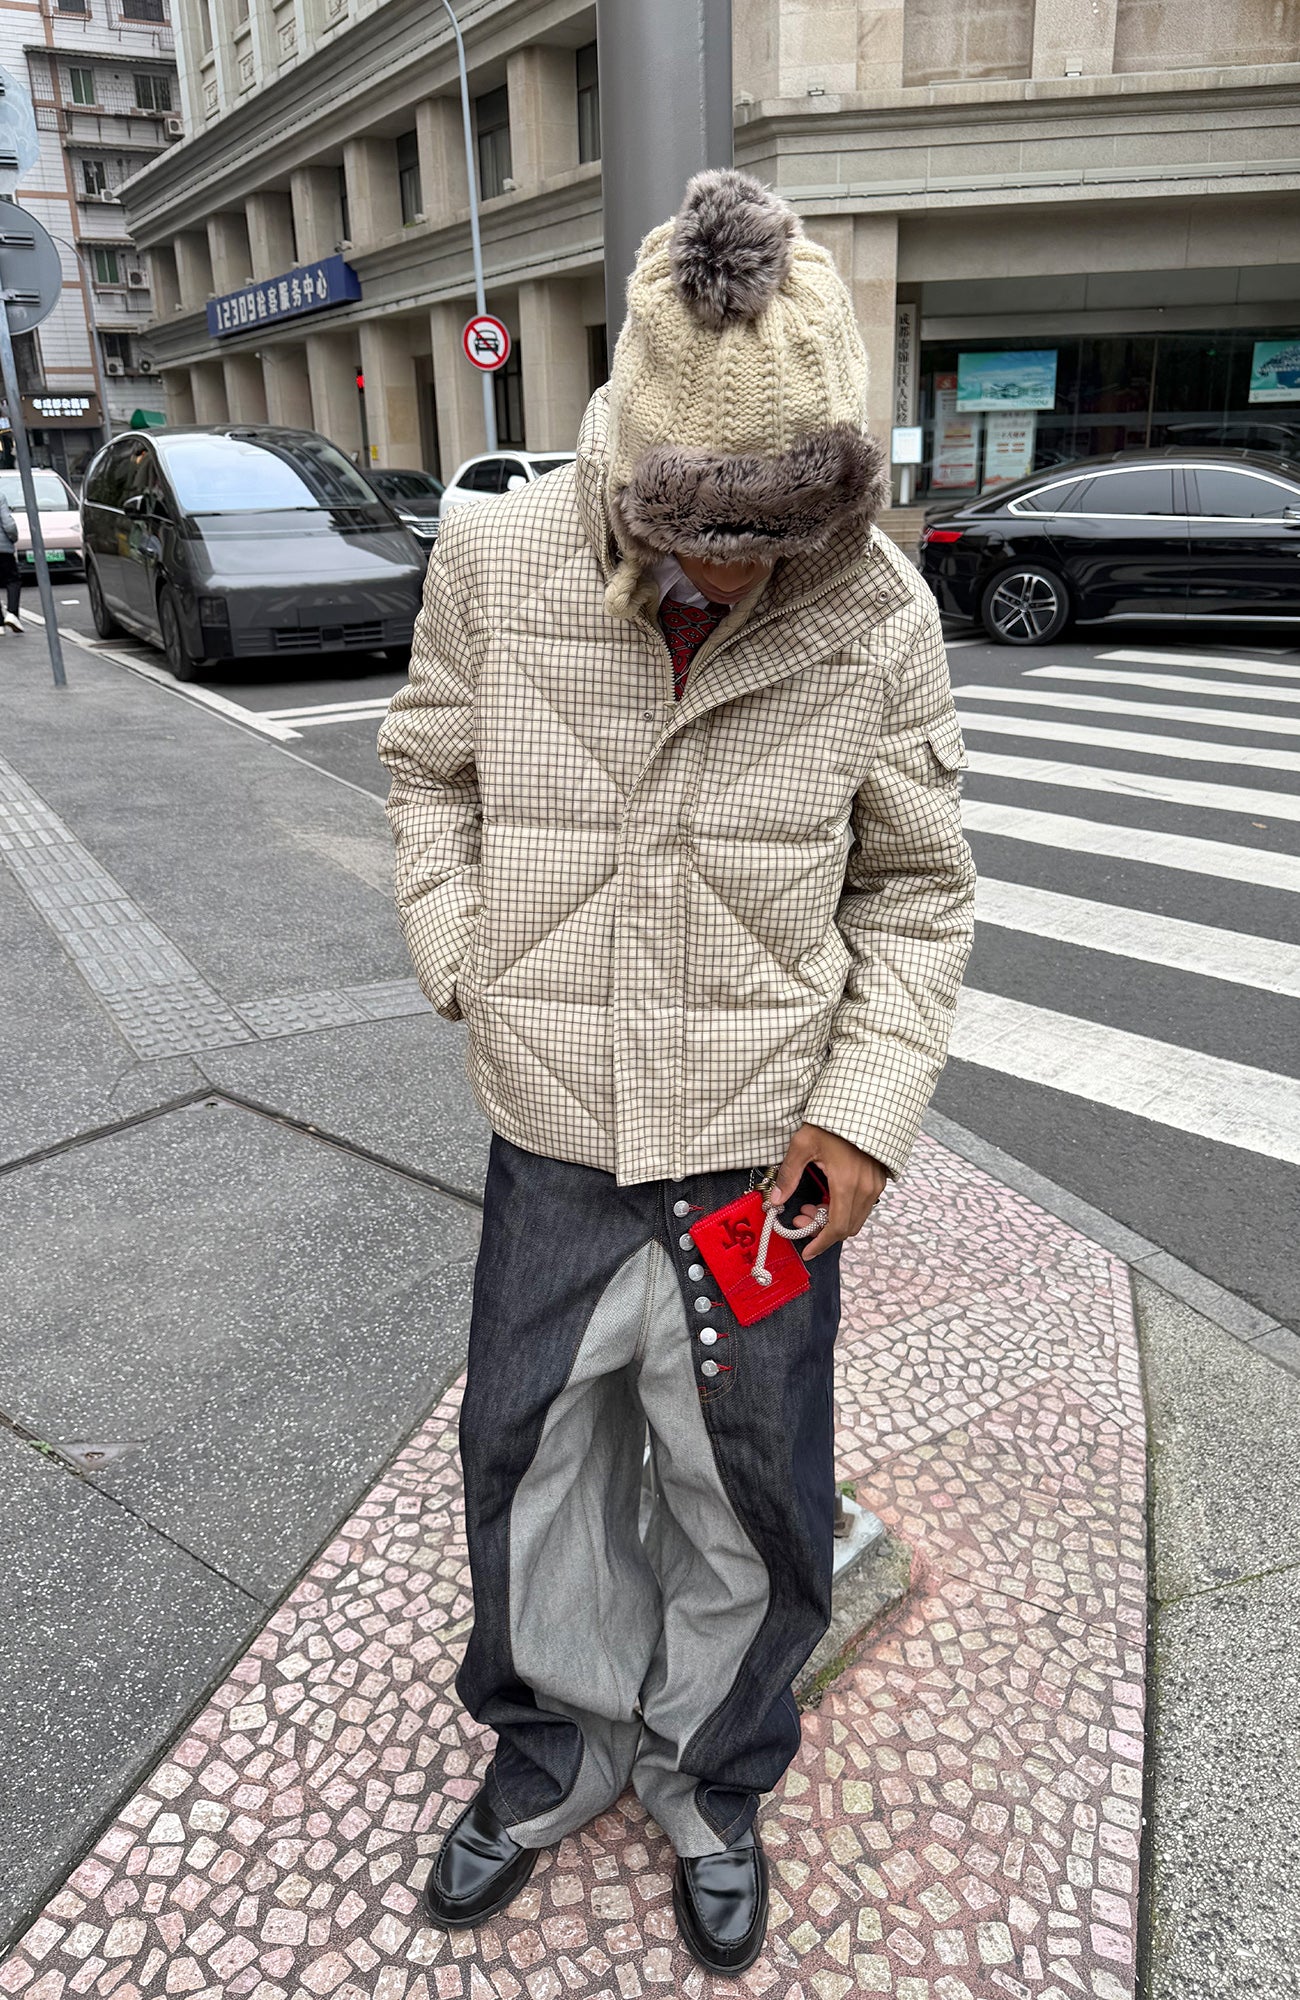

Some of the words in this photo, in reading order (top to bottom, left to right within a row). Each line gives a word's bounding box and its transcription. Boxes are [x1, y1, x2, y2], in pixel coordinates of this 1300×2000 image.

[216, 269, 327, 330] 12309检察服务中心
